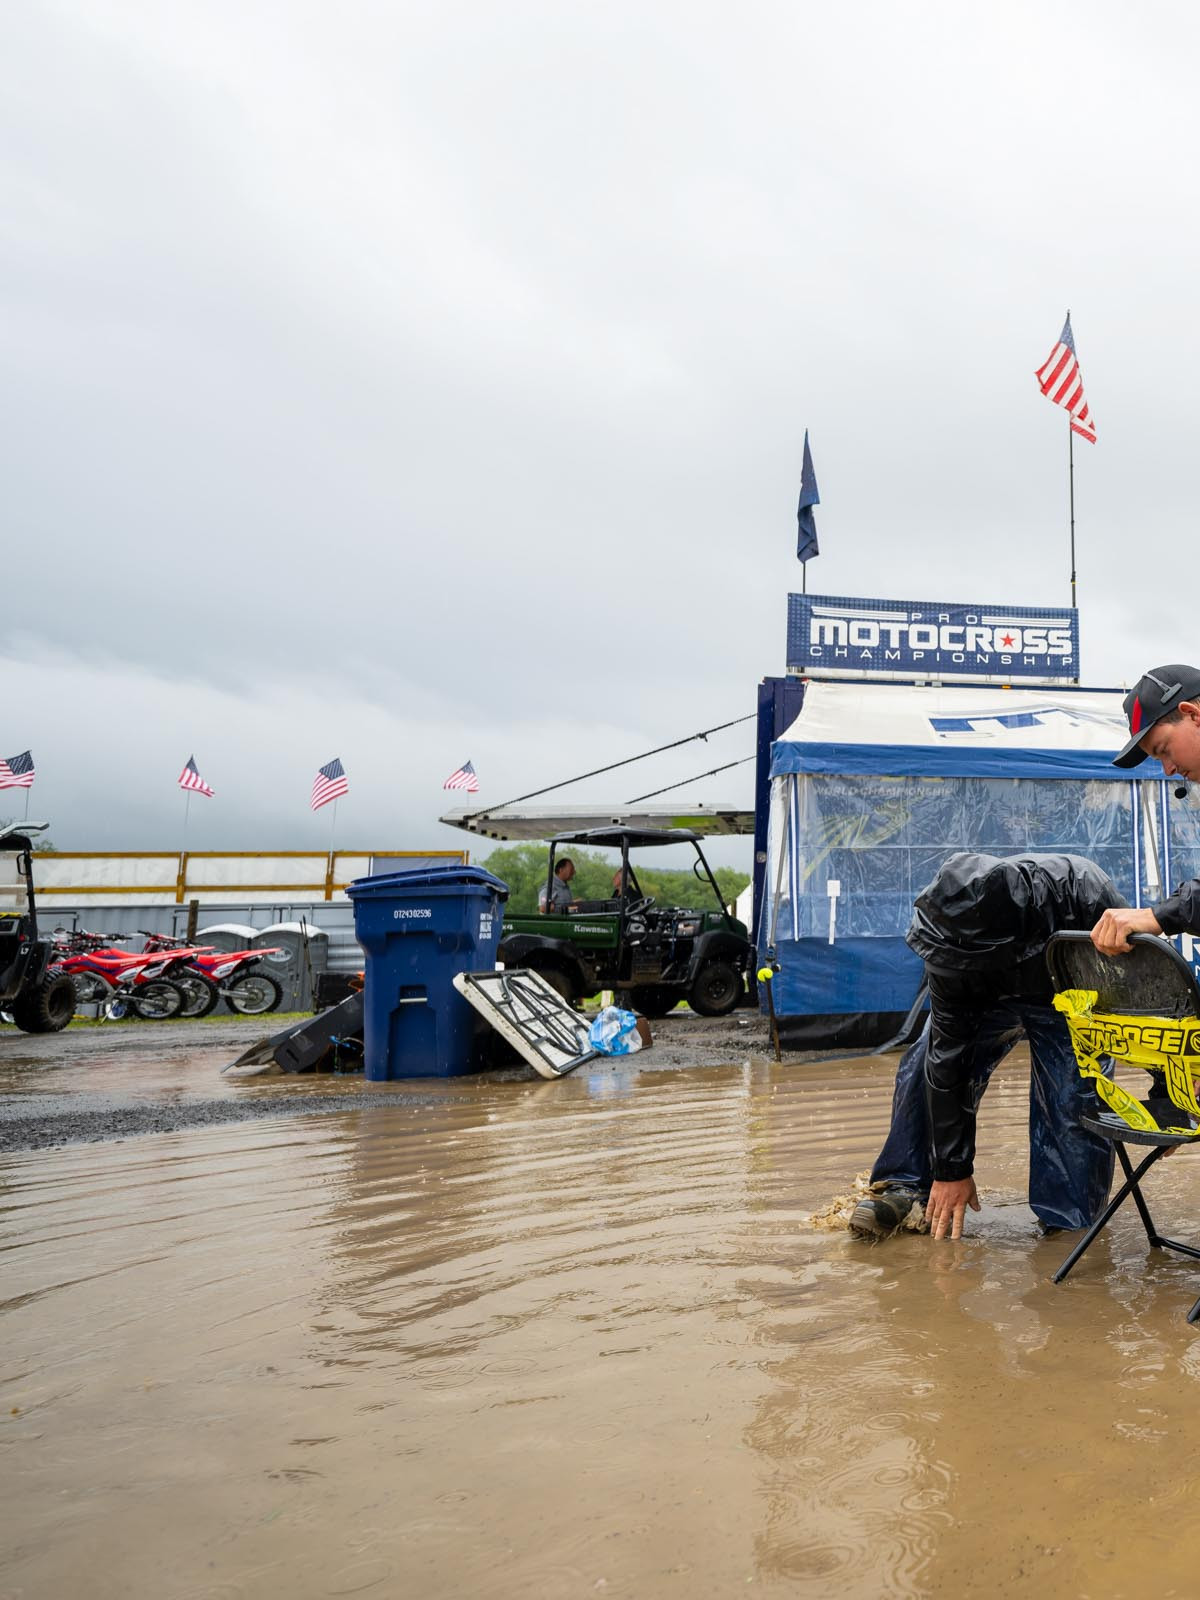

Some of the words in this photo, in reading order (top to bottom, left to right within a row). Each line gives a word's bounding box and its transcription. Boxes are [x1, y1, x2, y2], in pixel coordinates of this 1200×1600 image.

[912, 613, 978, 624] PRO
[810, 618, 1072, 655] MOTOCROSS
[810, 646, 1073, 666] CHAMPIONSHIP
